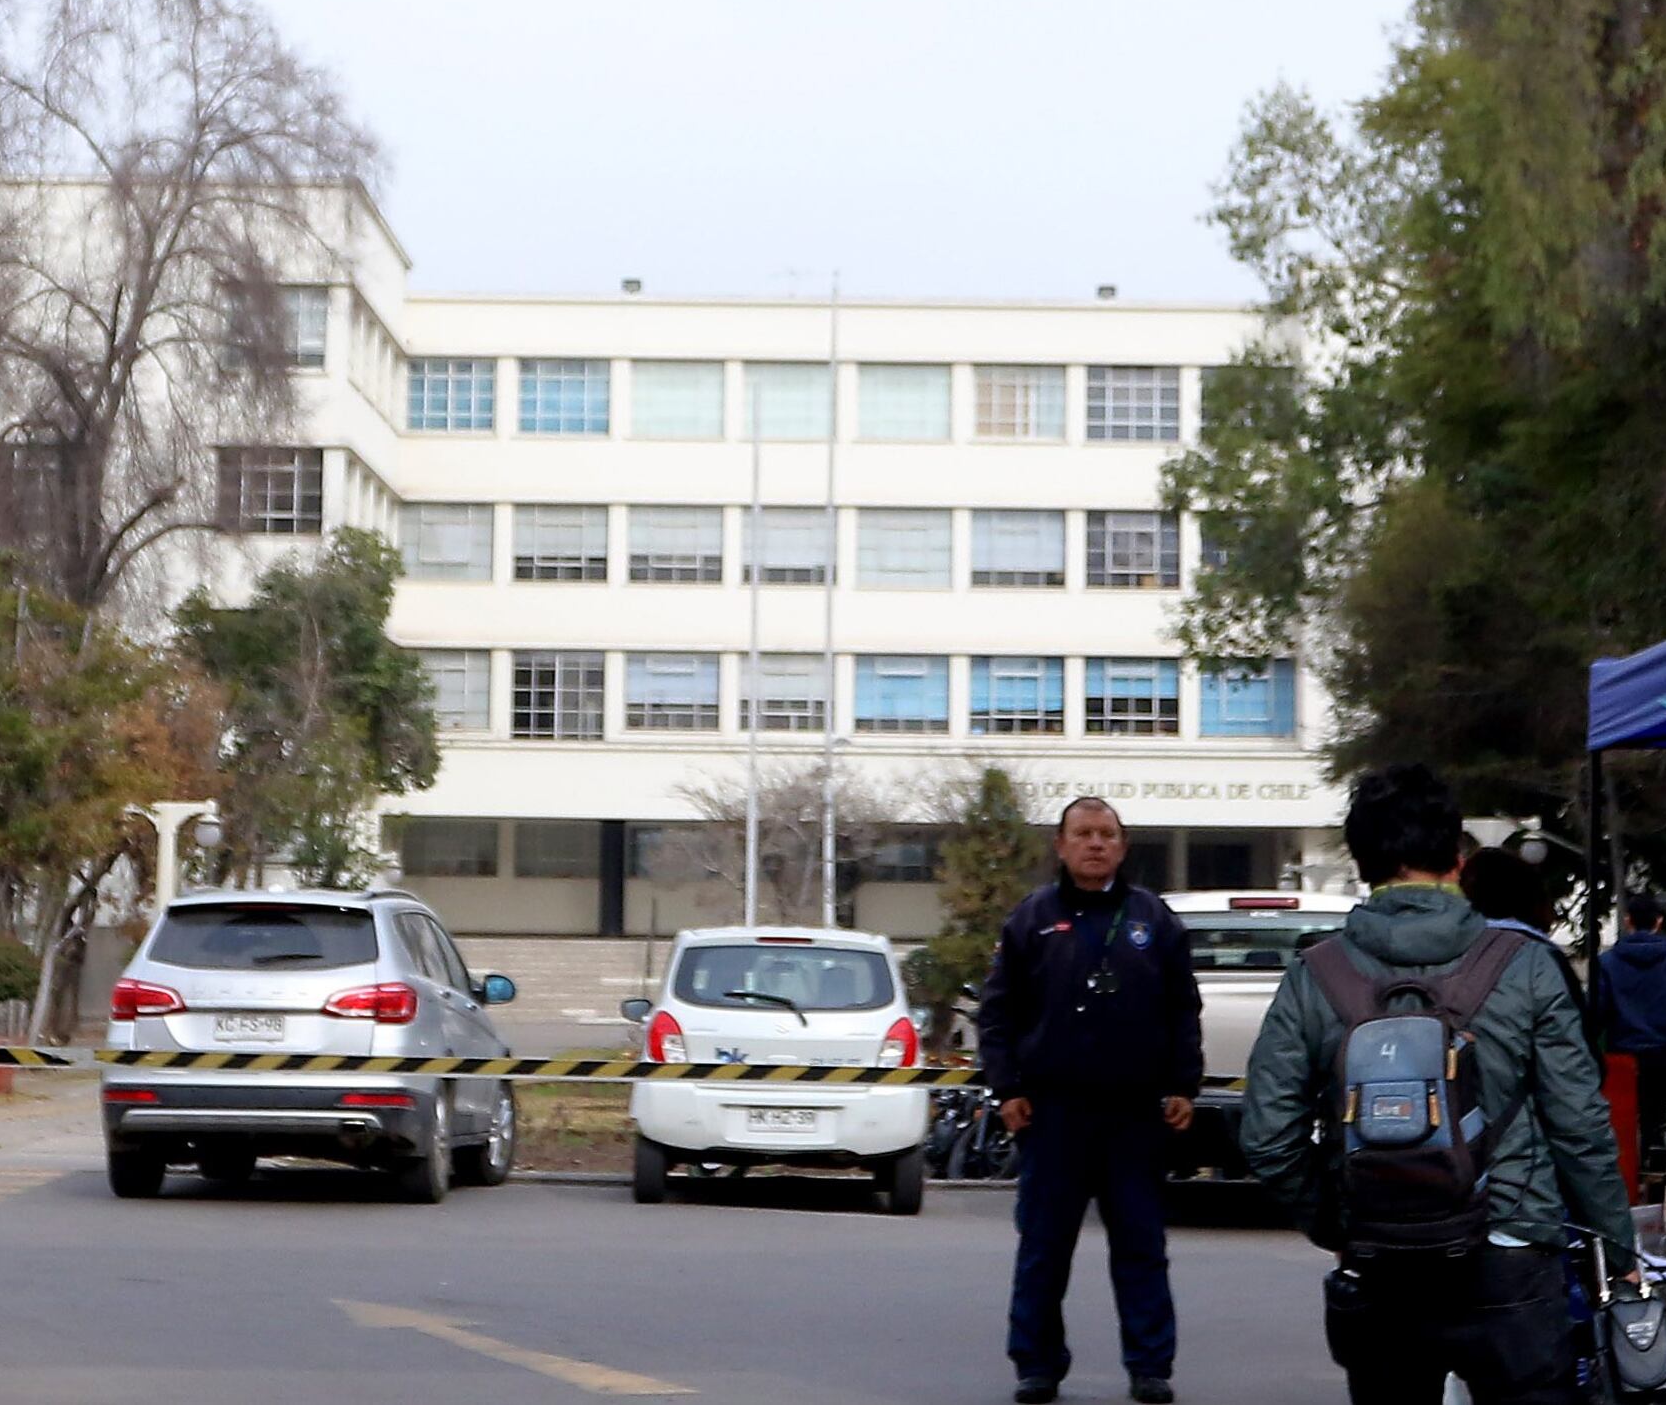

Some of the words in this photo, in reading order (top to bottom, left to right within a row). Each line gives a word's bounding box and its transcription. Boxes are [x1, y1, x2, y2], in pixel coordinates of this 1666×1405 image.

[1140, 781, 1221, 801] PUBLICA
[1226, 782, 1252, 801] DE
[1257, 782, 1311, 802] CHILE
